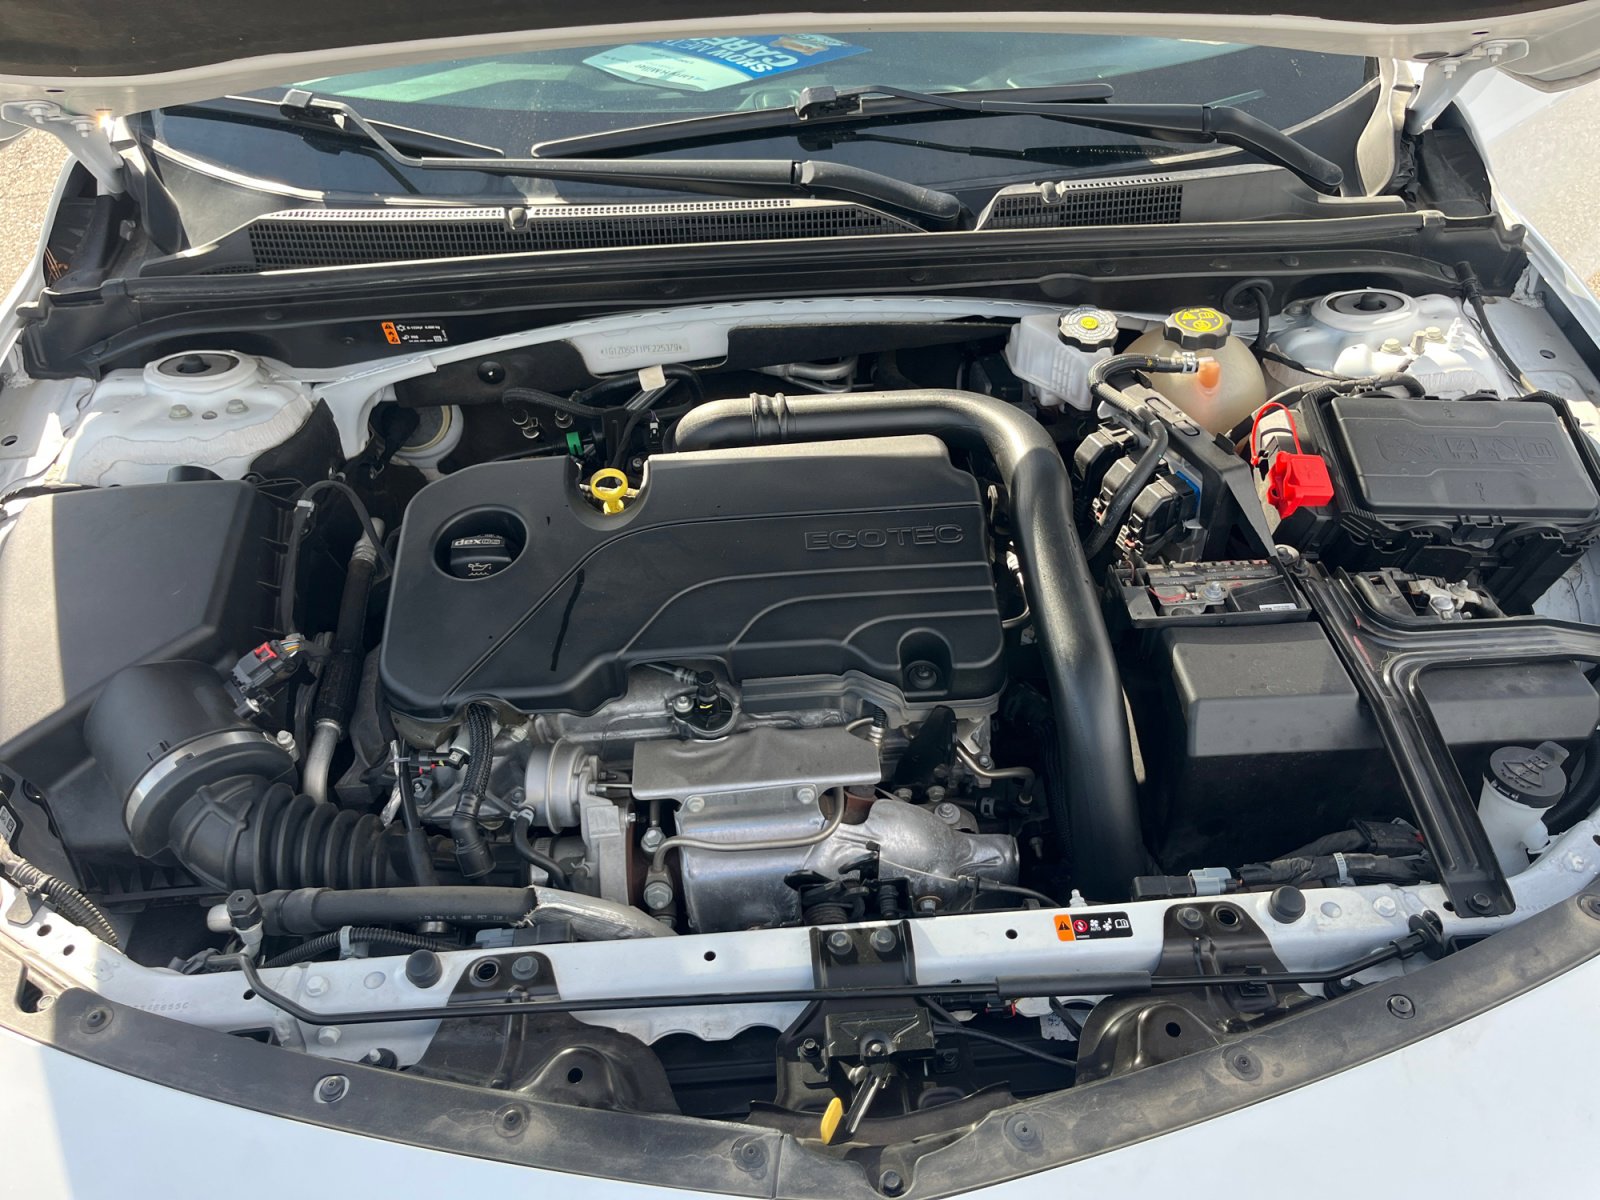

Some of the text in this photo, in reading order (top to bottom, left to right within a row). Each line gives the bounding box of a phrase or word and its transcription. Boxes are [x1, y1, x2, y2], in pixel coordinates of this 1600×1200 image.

[688, 37, 799, 68] CARF
[706, 49, 773, 73] SHOW
[804, 523, 964, 550] ECOTEC
